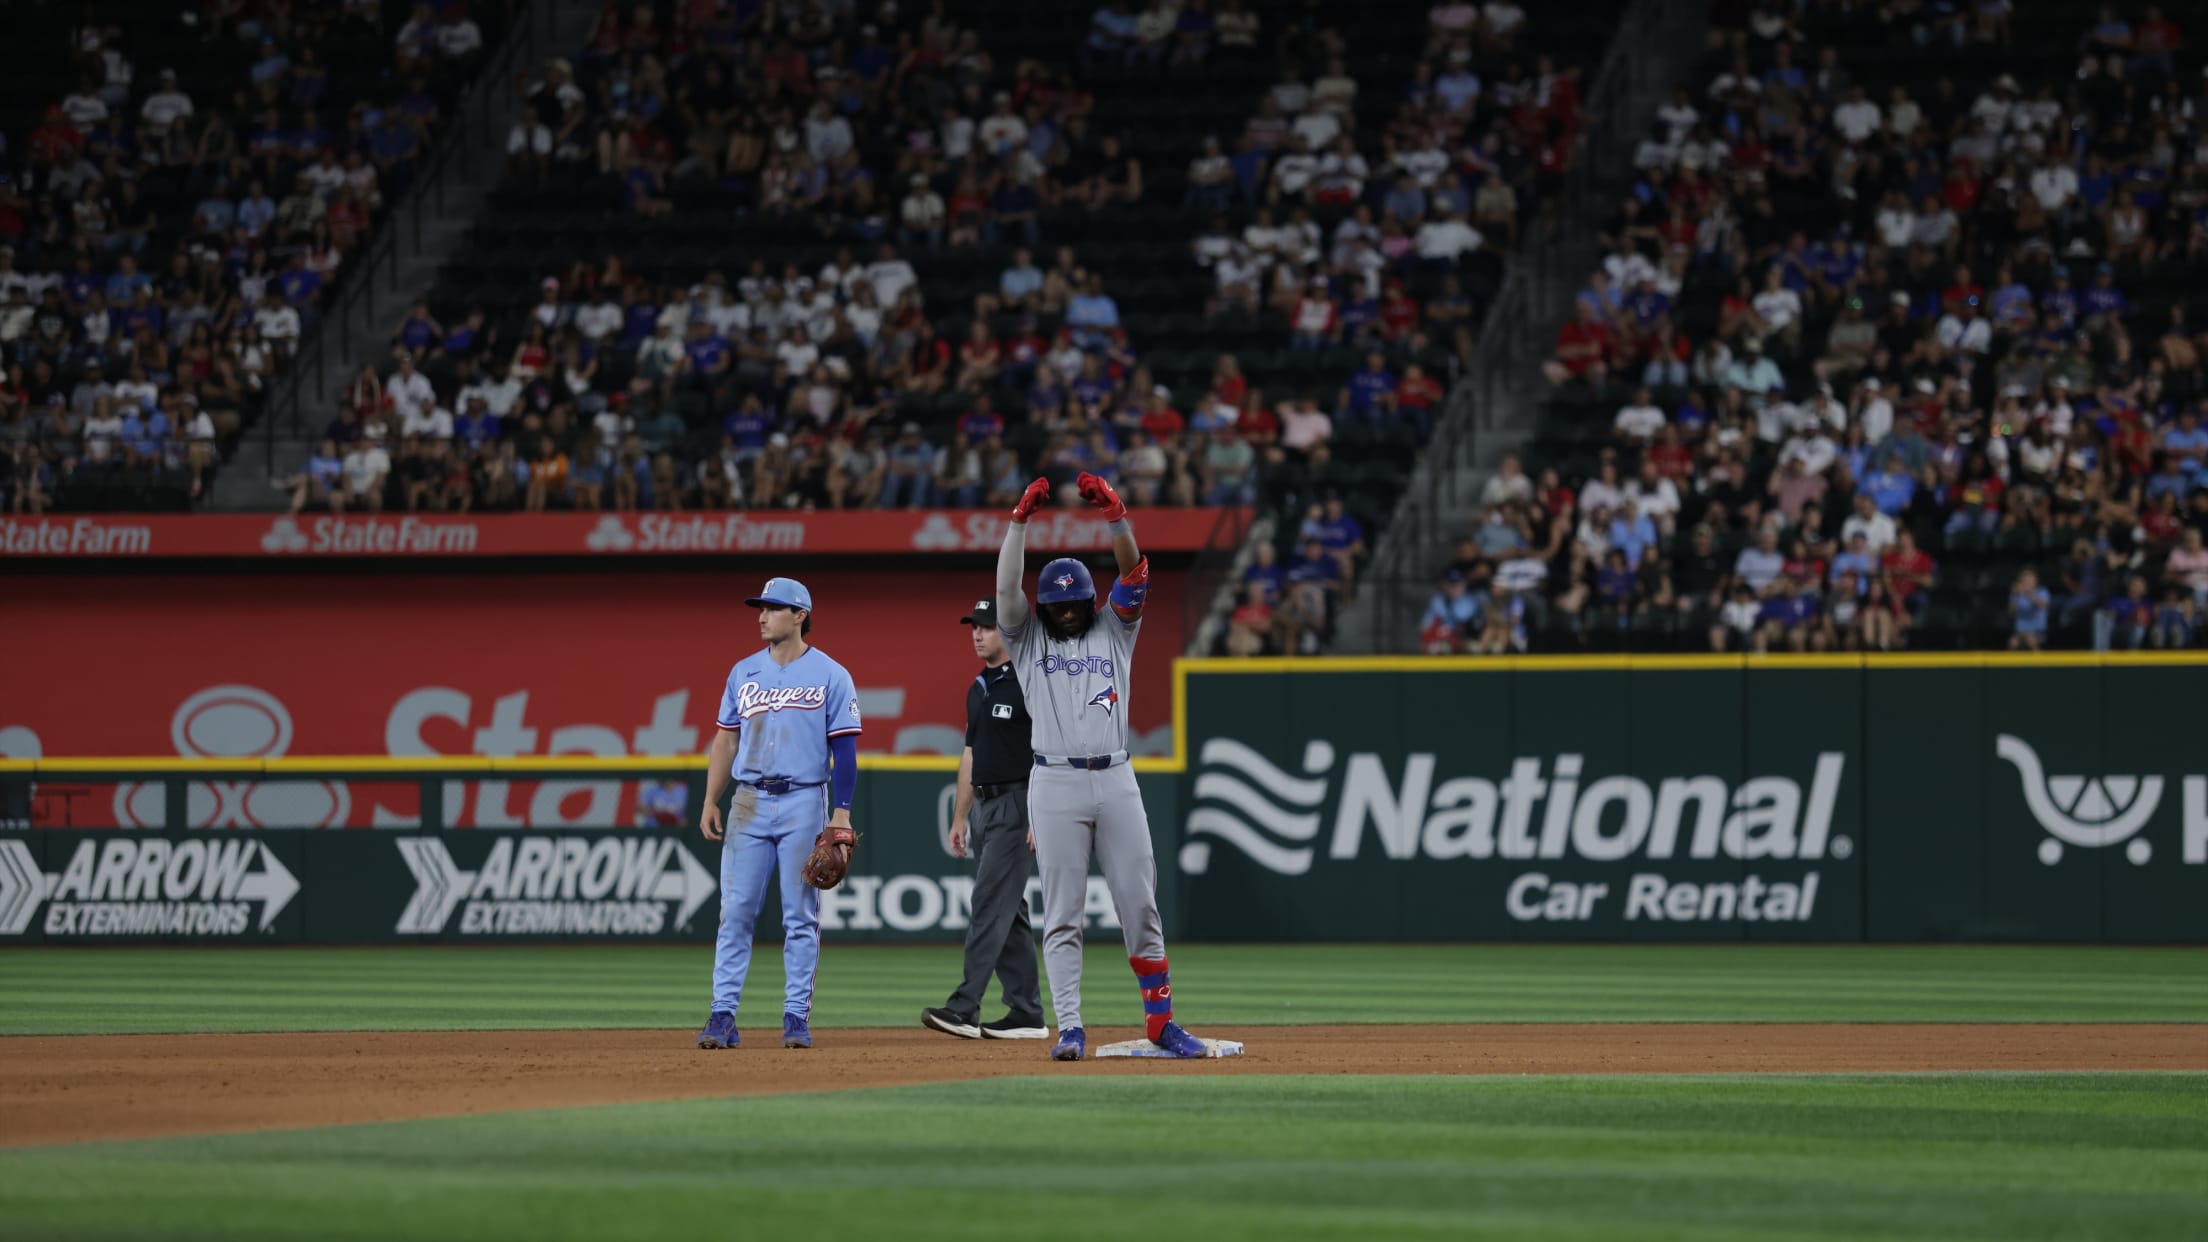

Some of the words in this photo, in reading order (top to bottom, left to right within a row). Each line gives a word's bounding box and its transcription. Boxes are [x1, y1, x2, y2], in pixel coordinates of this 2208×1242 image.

[965, 512, 1134, 550] SteFar
[738, 681, 827, 719] Rangers
[1331, 751, 1845, 861] National
[55, 838, 260, 901] ARROW
[470, 837, 676, 900] ARROW
[44, 901, 251, 935] EXTERMINATORS
[459, 900, 668, 934] EXTERMINATORS
[1506, 872, 1606, 922] Car
[1624, 872, 1818, 922] Rental
